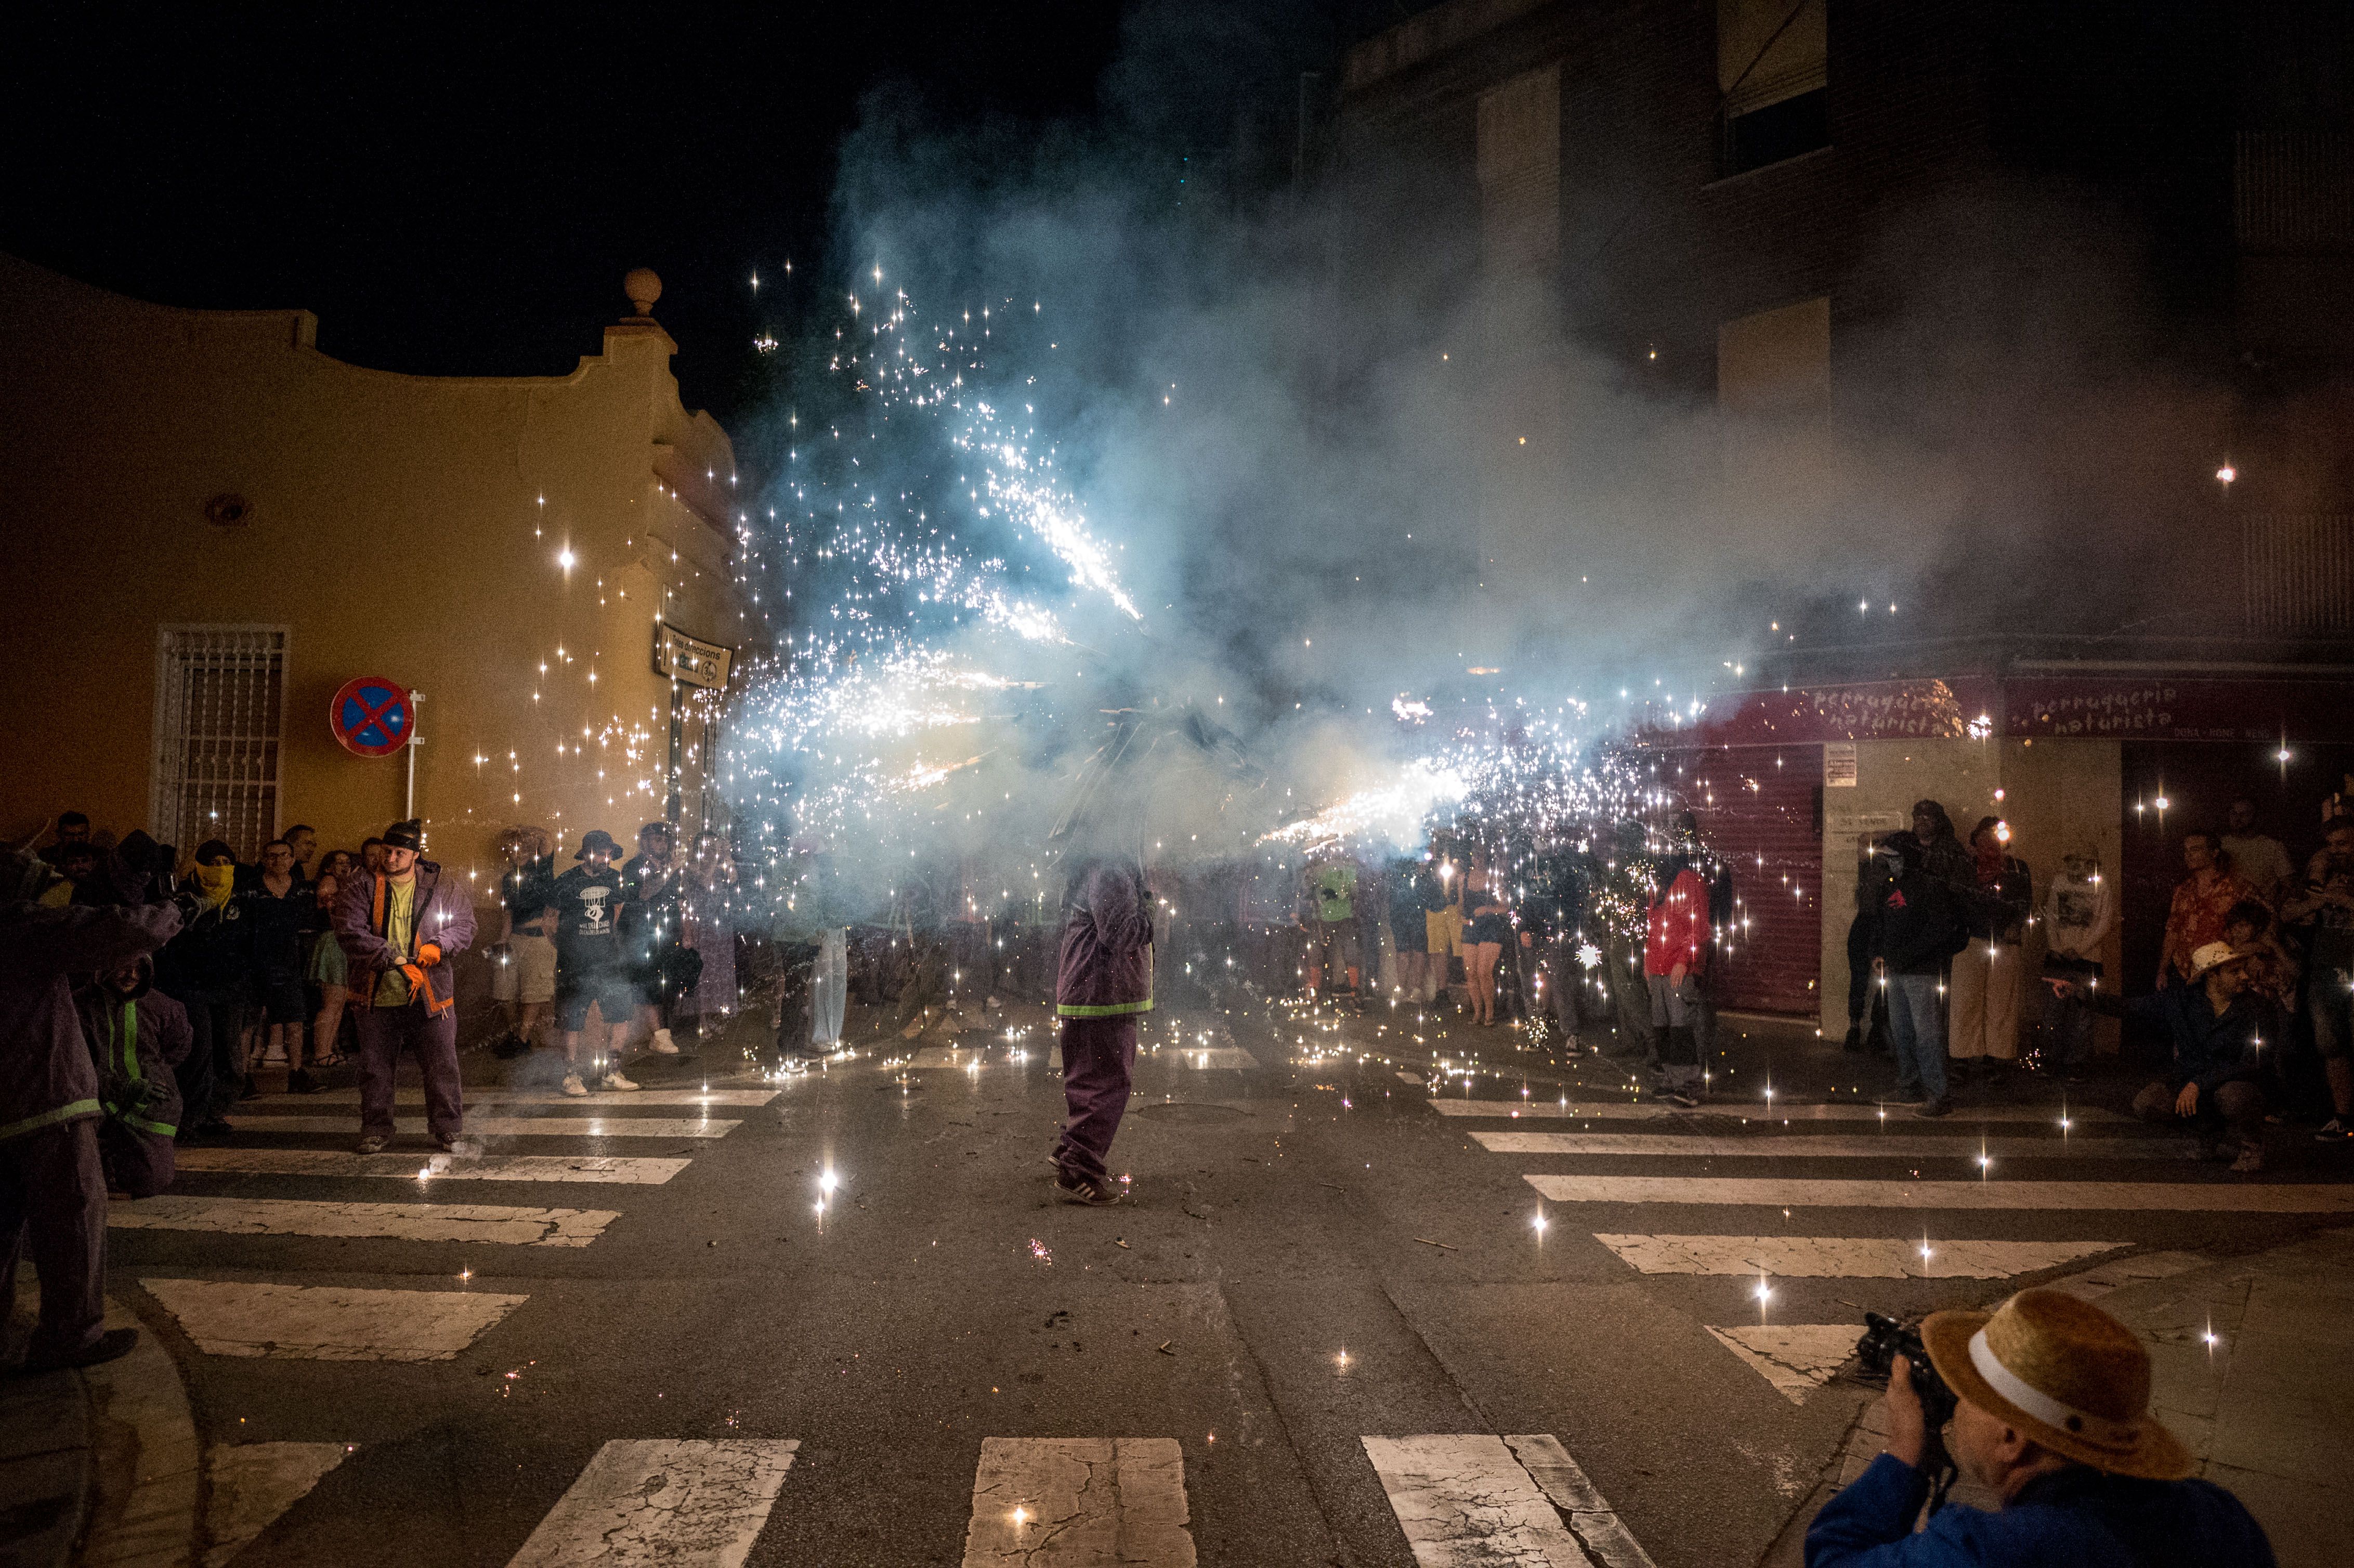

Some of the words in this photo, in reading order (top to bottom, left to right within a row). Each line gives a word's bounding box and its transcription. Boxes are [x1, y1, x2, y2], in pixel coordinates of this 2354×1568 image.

[673, 635, 684, 649] Totes
[684, 641, 721, 660] direccions
[2032, 682, 2177, 720] perruqueria
[1829, 710, 1946, 734] naturista
[2054, 707, 2172, 734] naturista
